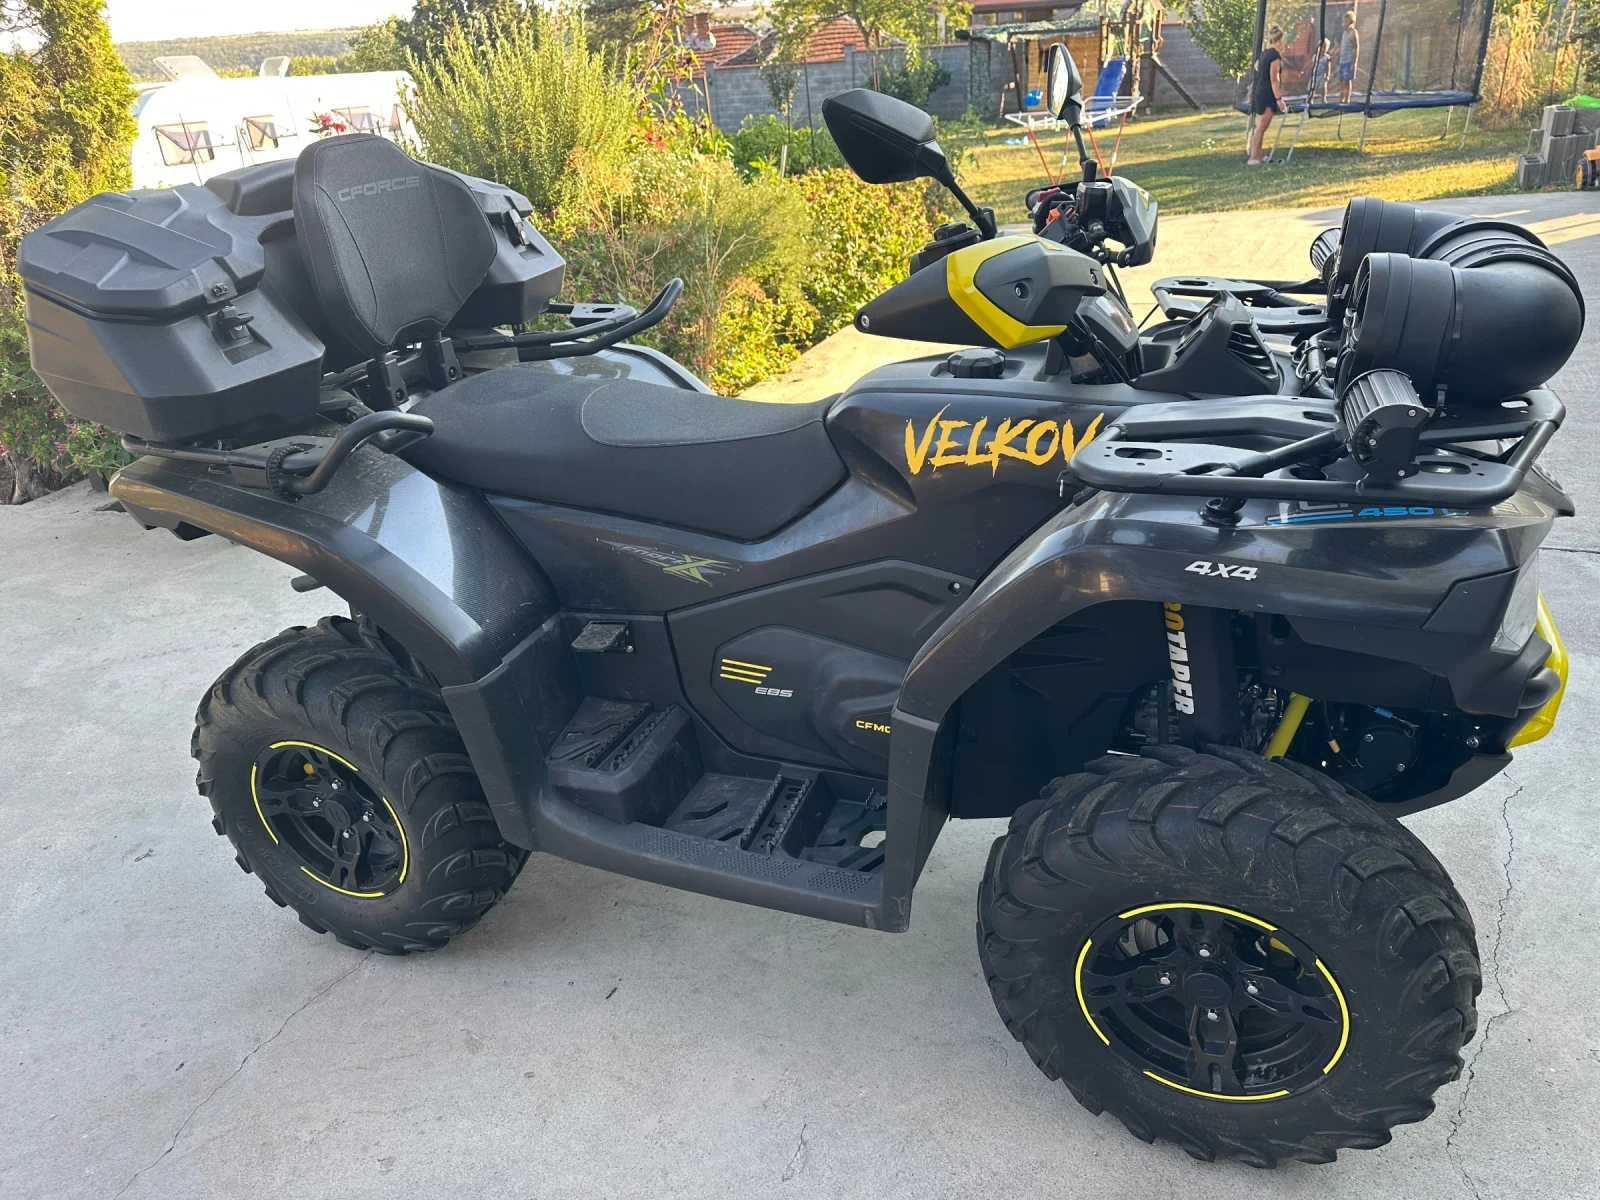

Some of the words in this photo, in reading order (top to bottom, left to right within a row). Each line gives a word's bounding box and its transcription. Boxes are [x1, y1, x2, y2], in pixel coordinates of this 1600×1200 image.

[337, 175, 420, 202] CFORCE
[1358, 507, 1435, 517] 450
[754, 686, 794, 698] EBS
